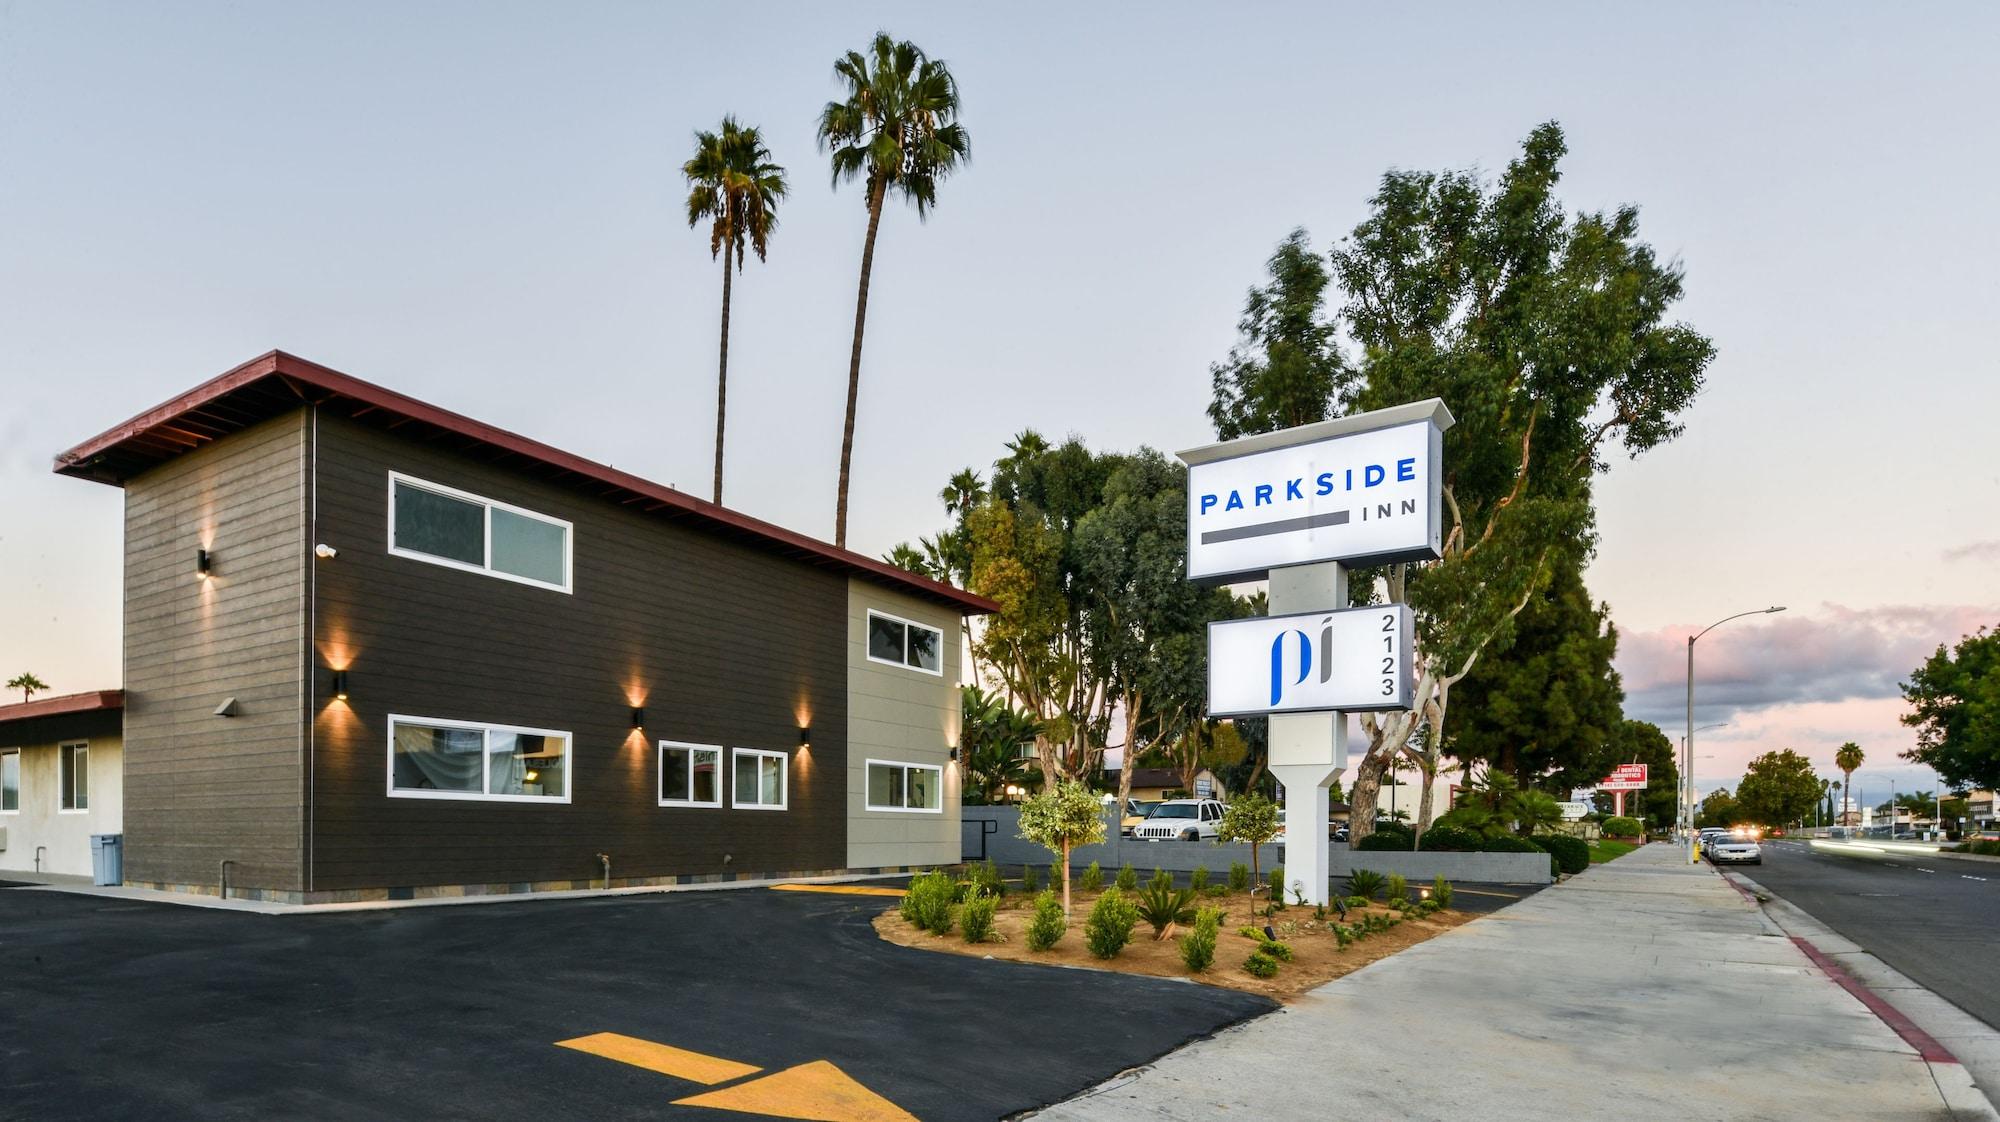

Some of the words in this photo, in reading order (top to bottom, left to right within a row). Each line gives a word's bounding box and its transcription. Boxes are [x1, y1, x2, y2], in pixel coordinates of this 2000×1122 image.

[1200, 457, 1416, 515] PARKSIDE
[1362, 499, 1416, 521] INN
[1381, 614, 1395, 697] 2123
